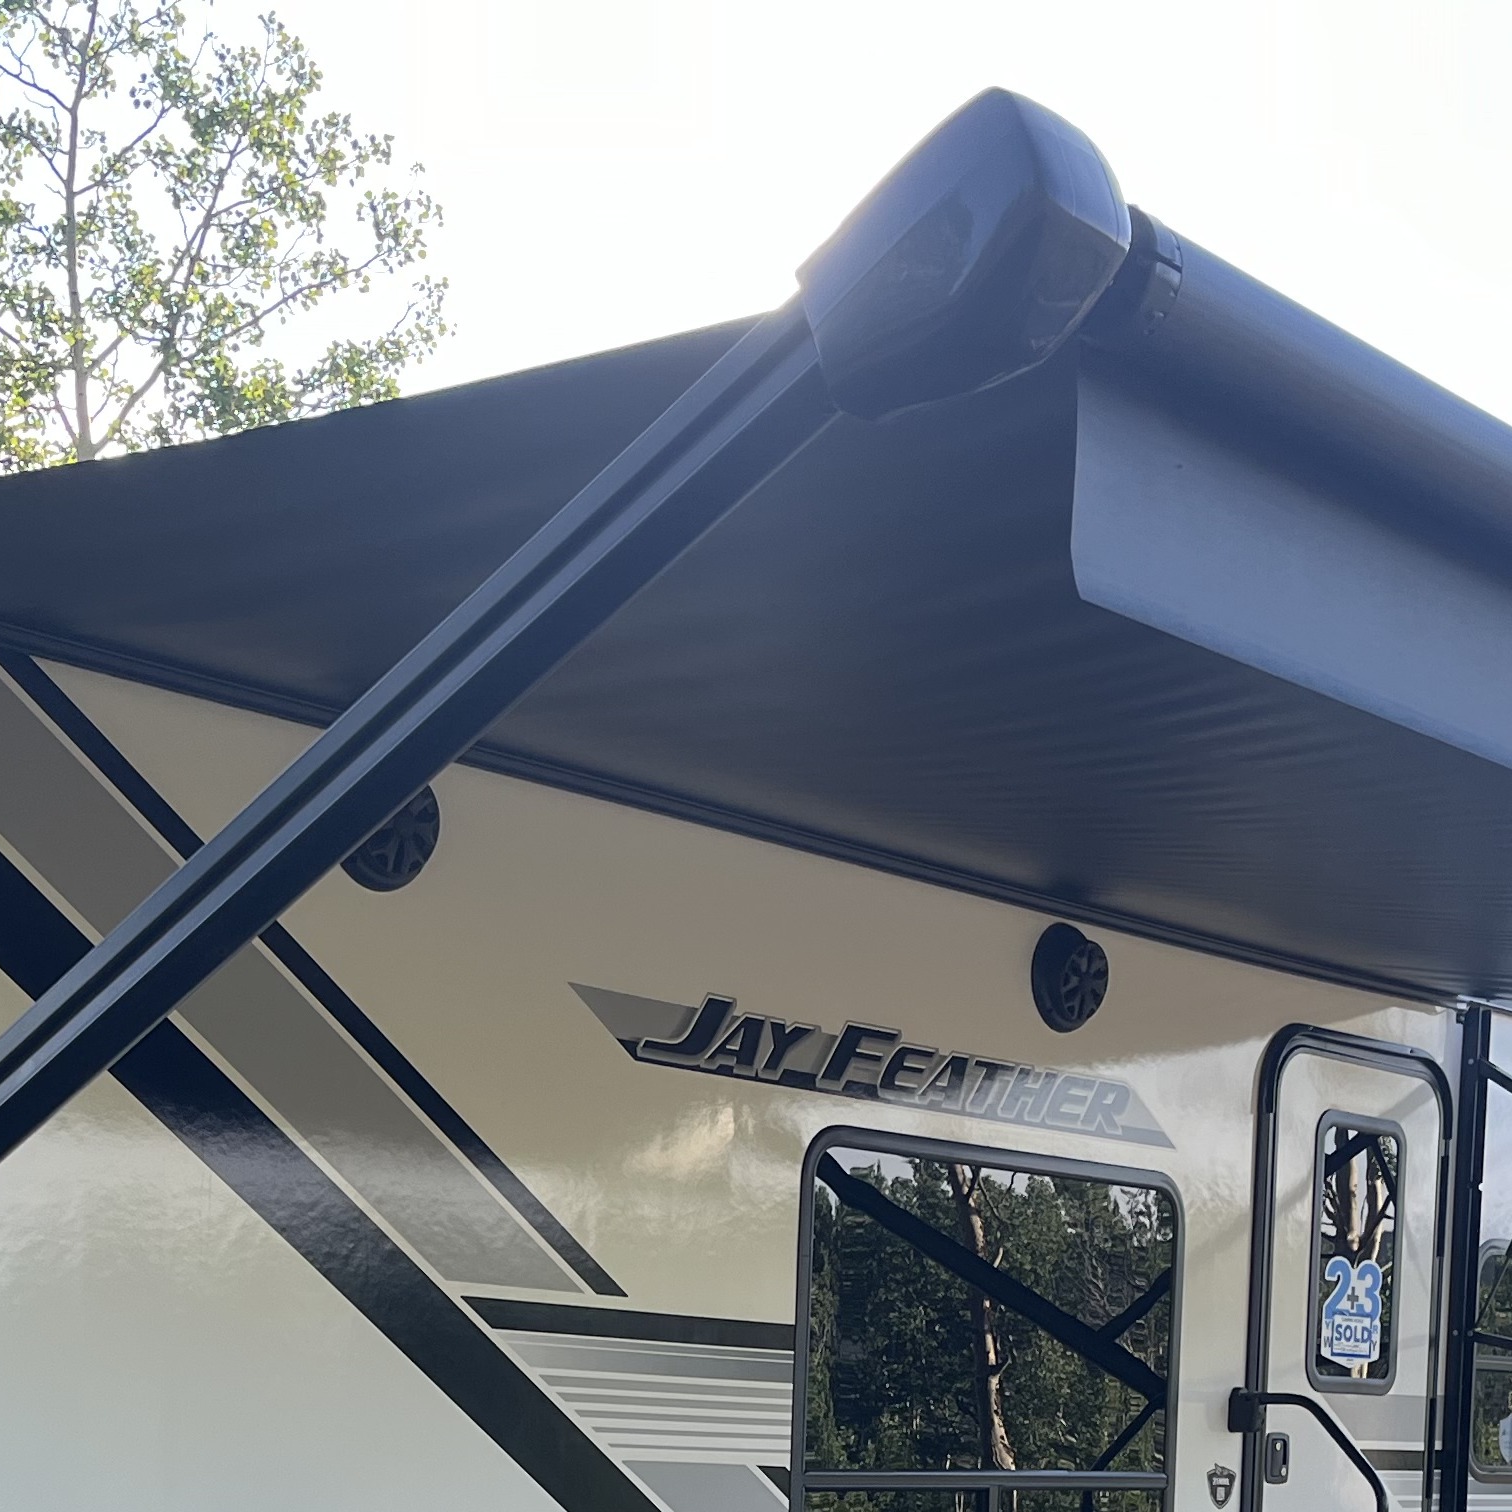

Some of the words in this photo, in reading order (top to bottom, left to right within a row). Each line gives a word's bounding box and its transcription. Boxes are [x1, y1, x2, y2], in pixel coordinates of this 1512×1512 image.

[636, 992, 814, 1081] JAY
[816, 1020, 1134, 1135] FEATHER
[1334, 1323, 1373, 1343] SOLD
